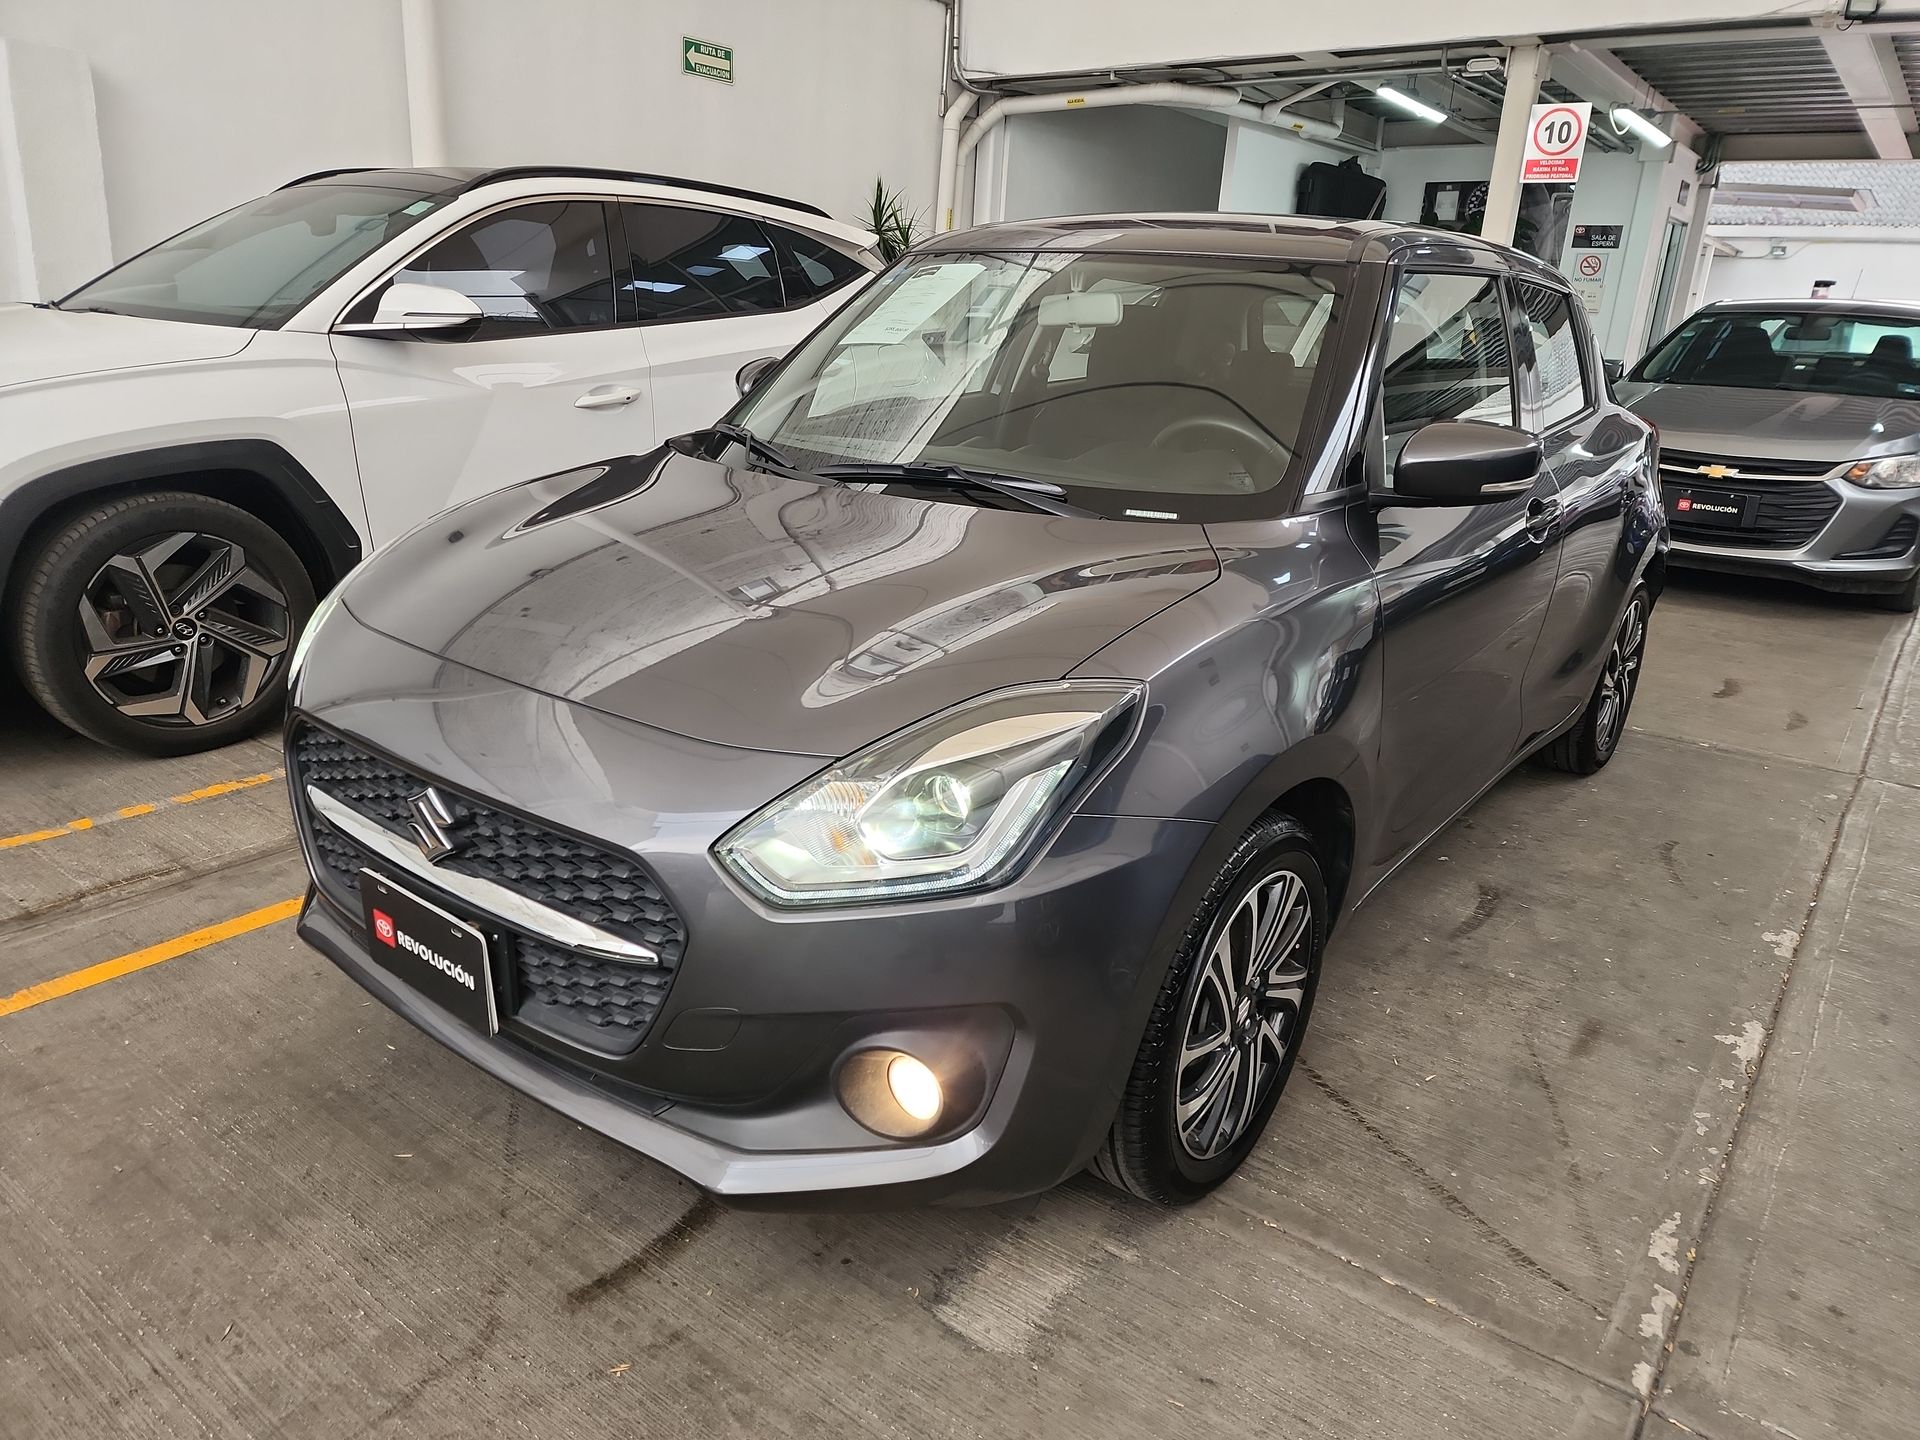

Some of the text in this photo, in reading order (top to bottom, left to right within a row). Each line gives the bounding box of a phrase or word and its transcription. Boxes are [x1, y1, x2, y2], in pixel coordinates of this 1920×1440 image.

[700, 45, 726, 58] RUTA DE
[1544, 120, 1572, 144] 10
[1691, 502, 1738, 514] REVOLUCIÓN
[396, 930, 475, 991] REVOLUCIÓN
